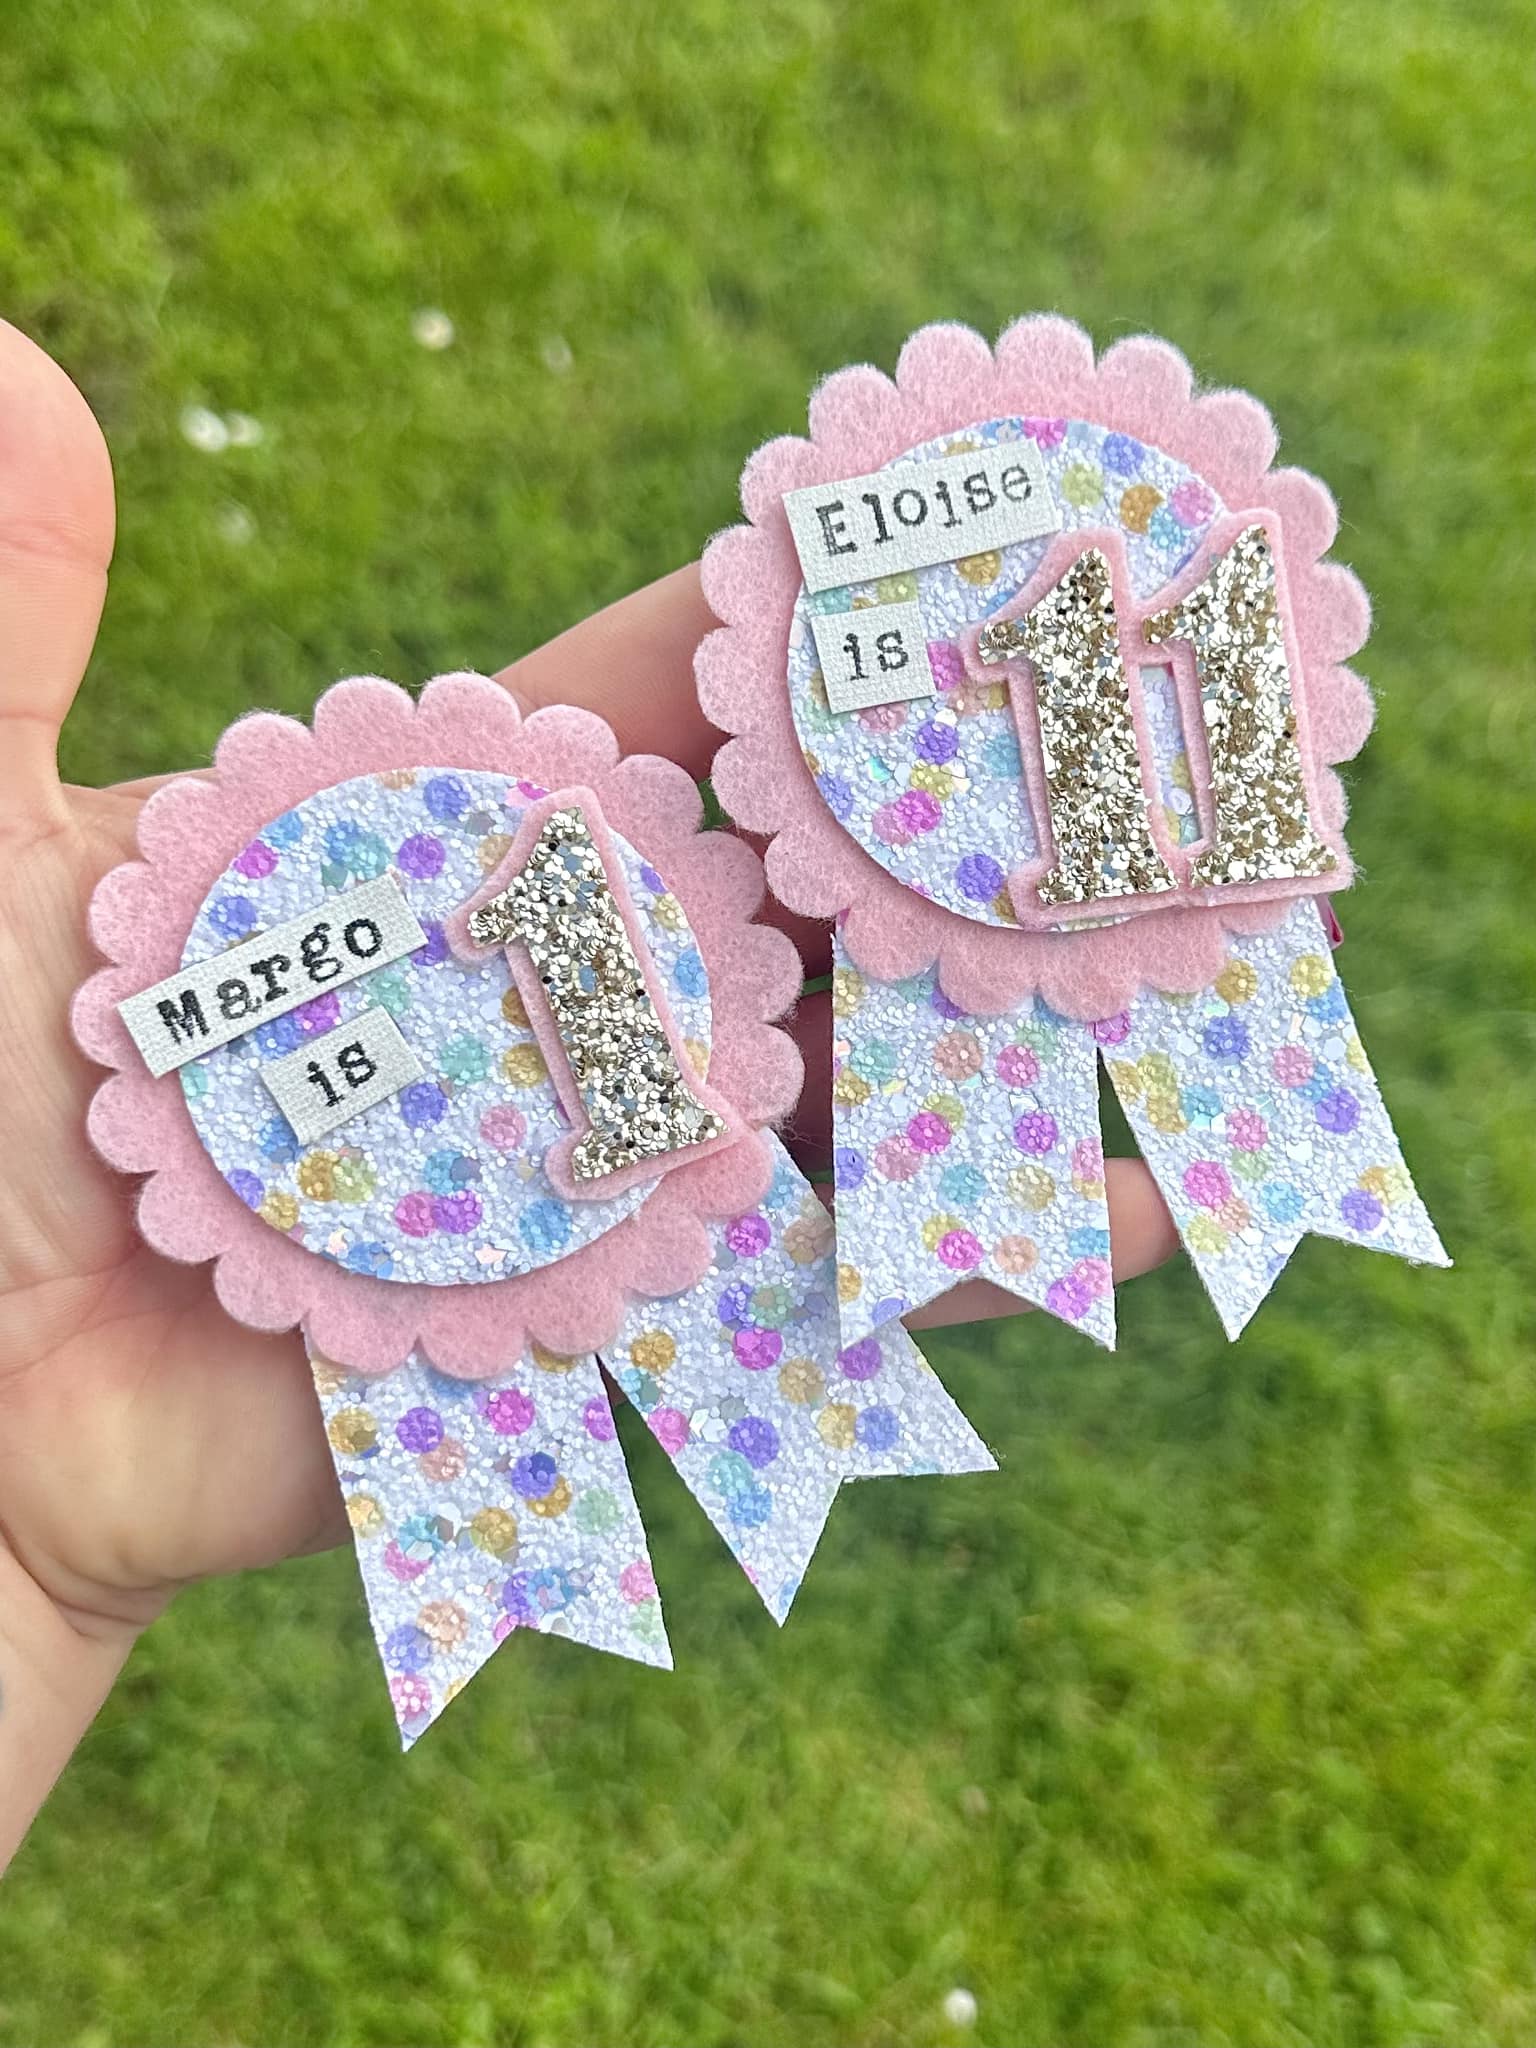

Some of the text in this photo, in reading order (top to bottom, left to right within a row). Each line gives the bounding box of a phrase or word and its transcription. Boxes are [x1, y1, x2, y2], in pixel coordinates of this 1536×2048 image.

[815, 464, 1033, 557] Eloise
[843, 629, 909, 681] is
[977, 523, 1340, 905] 11
[156, 917, 383, 1046] Margo
[467, 806, 731, 1182] 1
[306, 1040, 378, 1108] is
